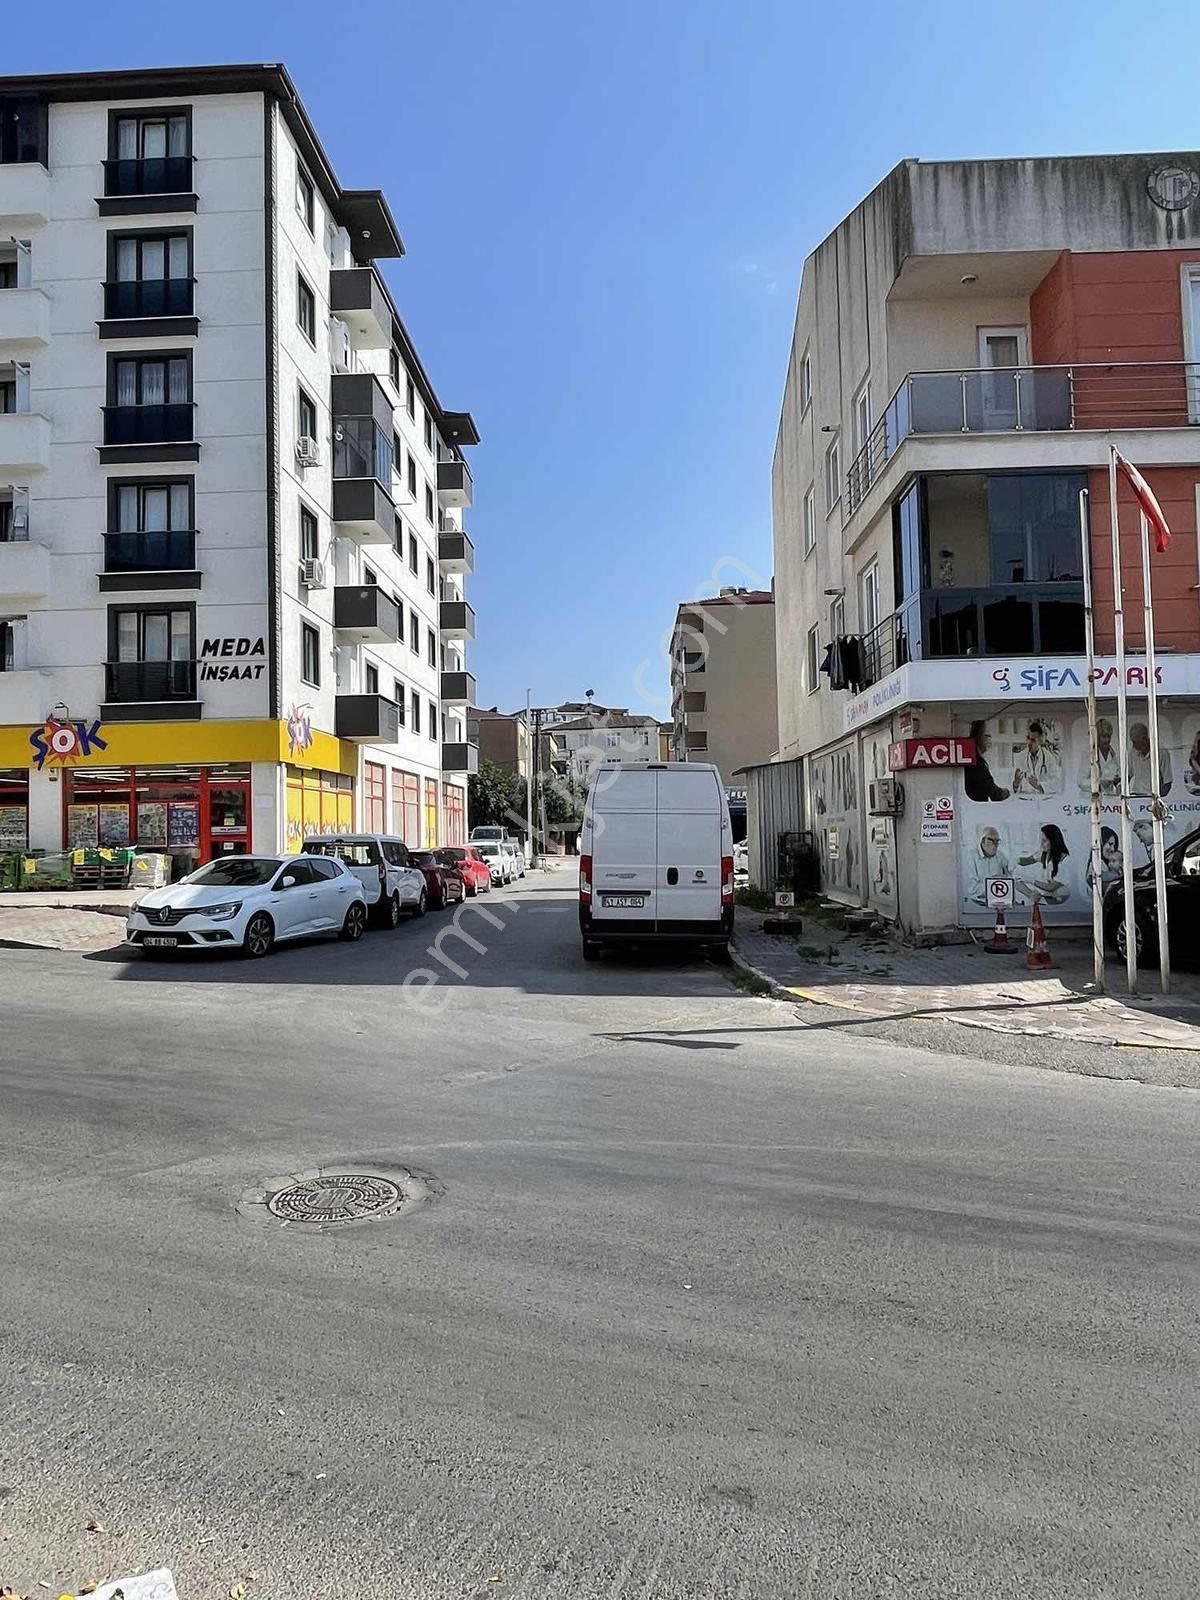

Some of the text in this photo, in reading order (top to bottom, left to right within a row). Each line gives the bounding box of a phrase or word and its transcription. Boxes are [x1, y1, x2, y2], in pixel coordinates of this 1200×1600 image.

[201, 637, 265, 657] MEDA
[200, 662, 265, 682] İNŞAAT
[1020, 665, 1163, 690] ŞİFA PARK
[29, 719, 108, 771] ŞOK
[912, 739, 972, 764] ACİL
[1139, 802, 1200, 813] POKLİNİĞ
